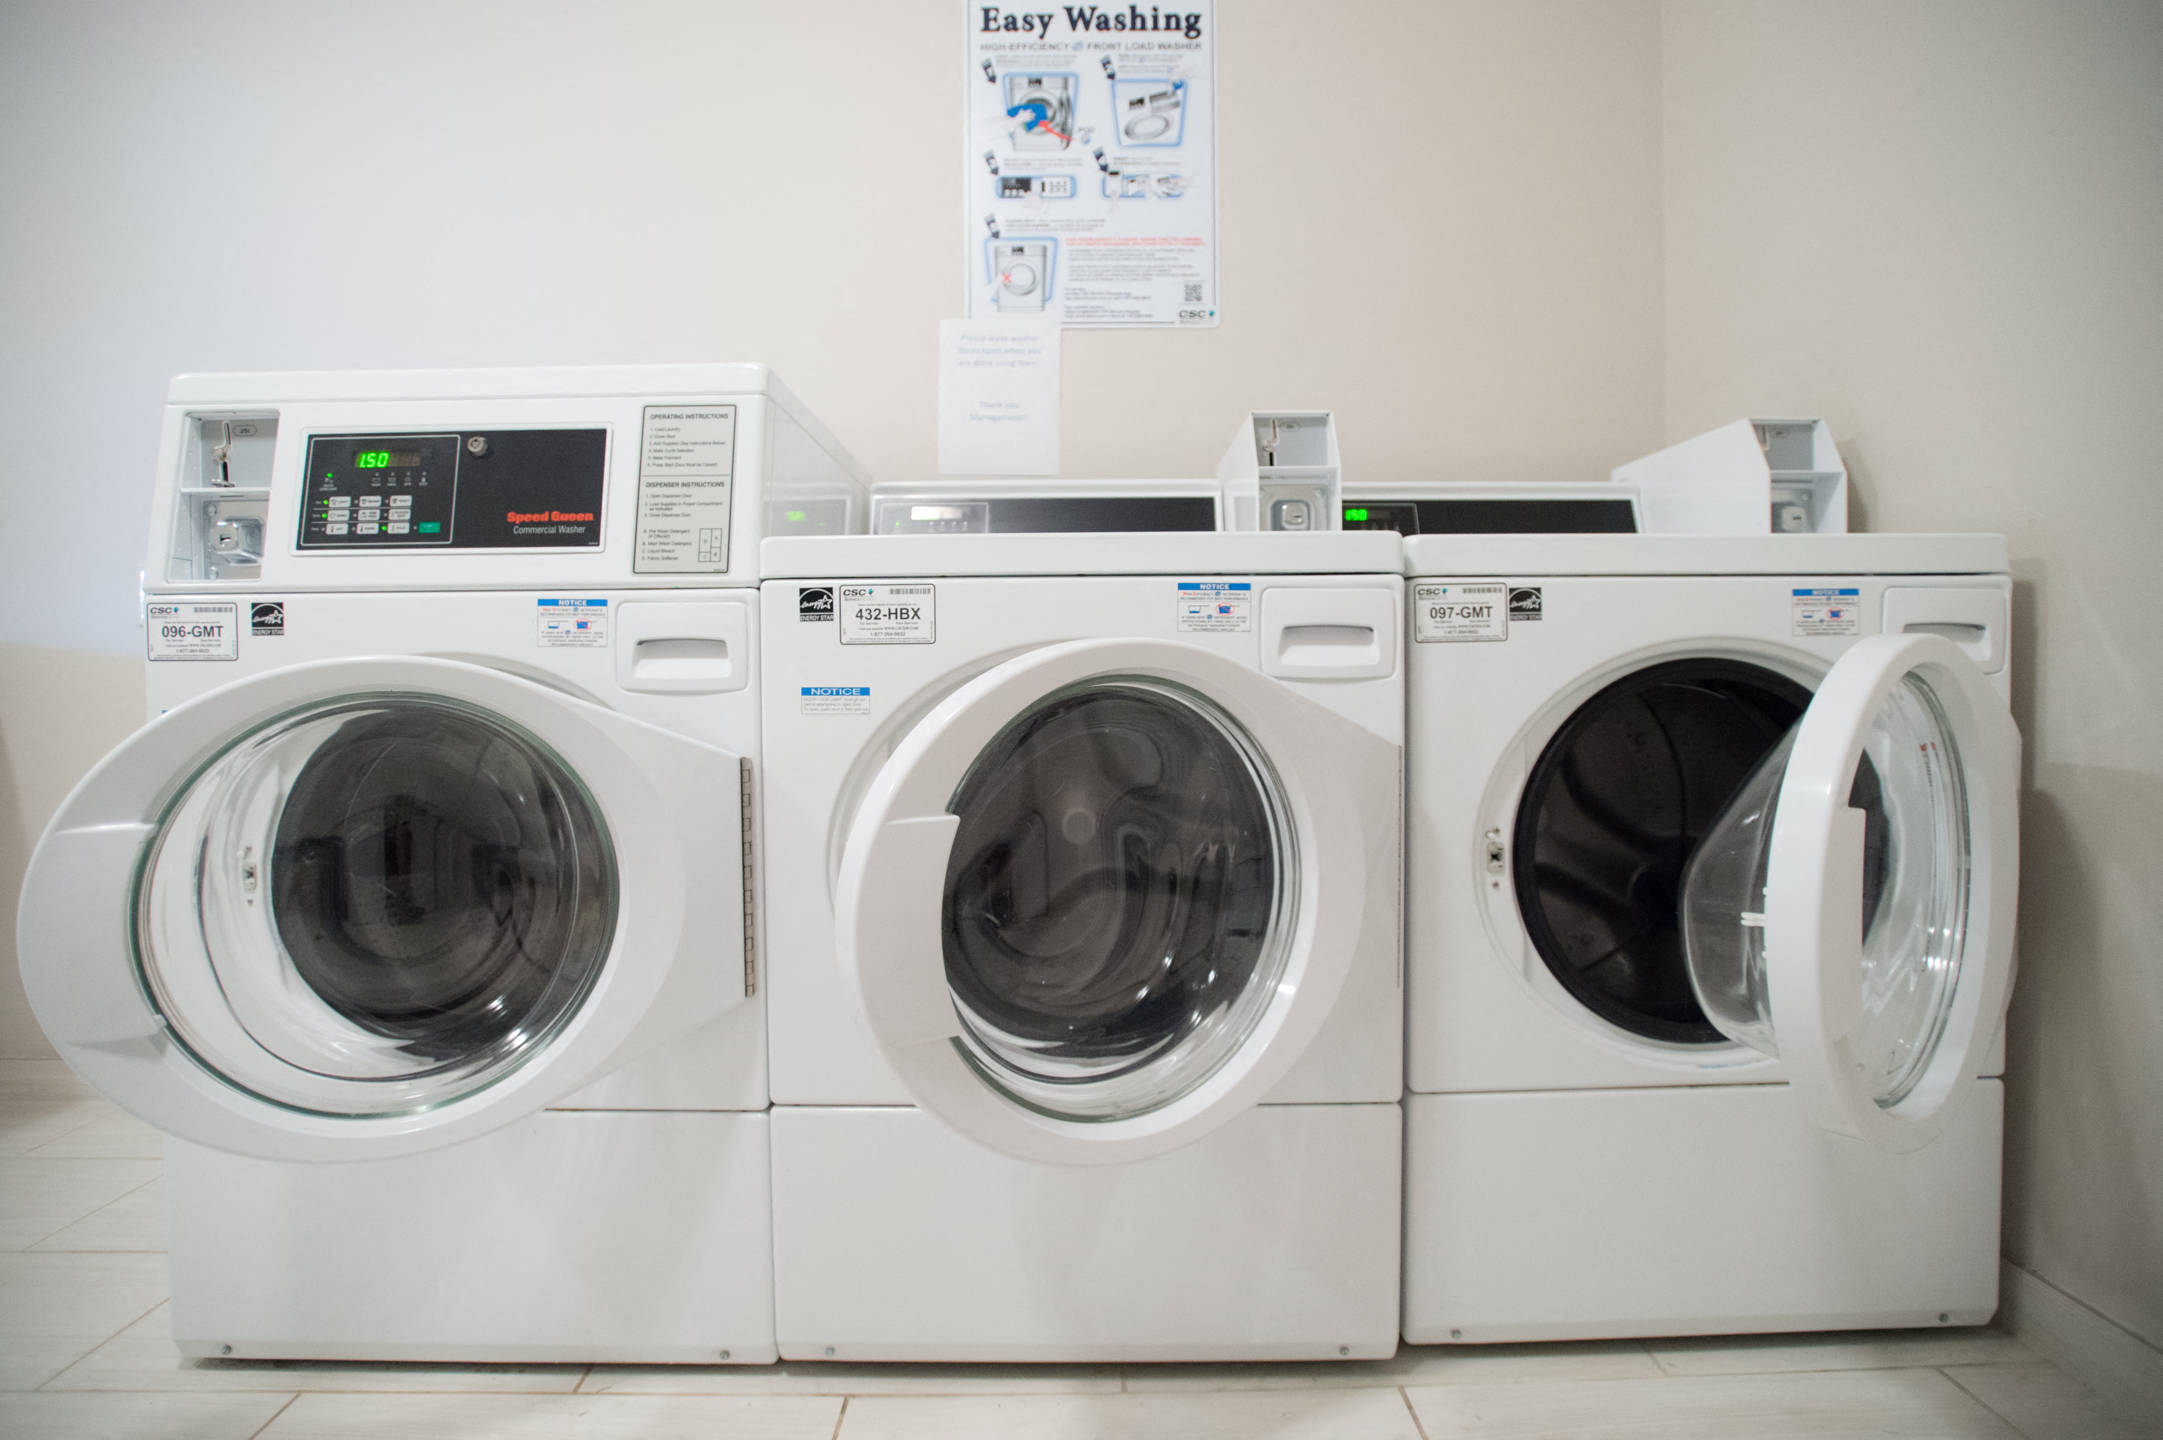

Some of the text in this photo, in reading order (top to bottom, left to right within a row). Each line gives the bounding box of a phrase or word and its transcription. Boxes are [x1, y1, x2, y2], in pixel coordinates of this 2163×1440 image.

[981, 4, 1202, 39] Easy Washing
[1087, 42, 1121, 50] FRONT
[1125, 42, 1154, 50] LOAD
[1158, 42, 1202, 50] WASHER
[1178, 310, 1206, 319] CSC
[507, 511, 594, 524] Speed Queen
[513, 525, 586, 535] Commercial Washer
[1417, 588, 1440, 596] CSC
[855, 607, 921, 620] 432-HBX
[1430, 606, 1493, 619] 097-GMT
[162, 625, 223, 638] 096-GMT
[811, 688, 860, 696] NOTICE
